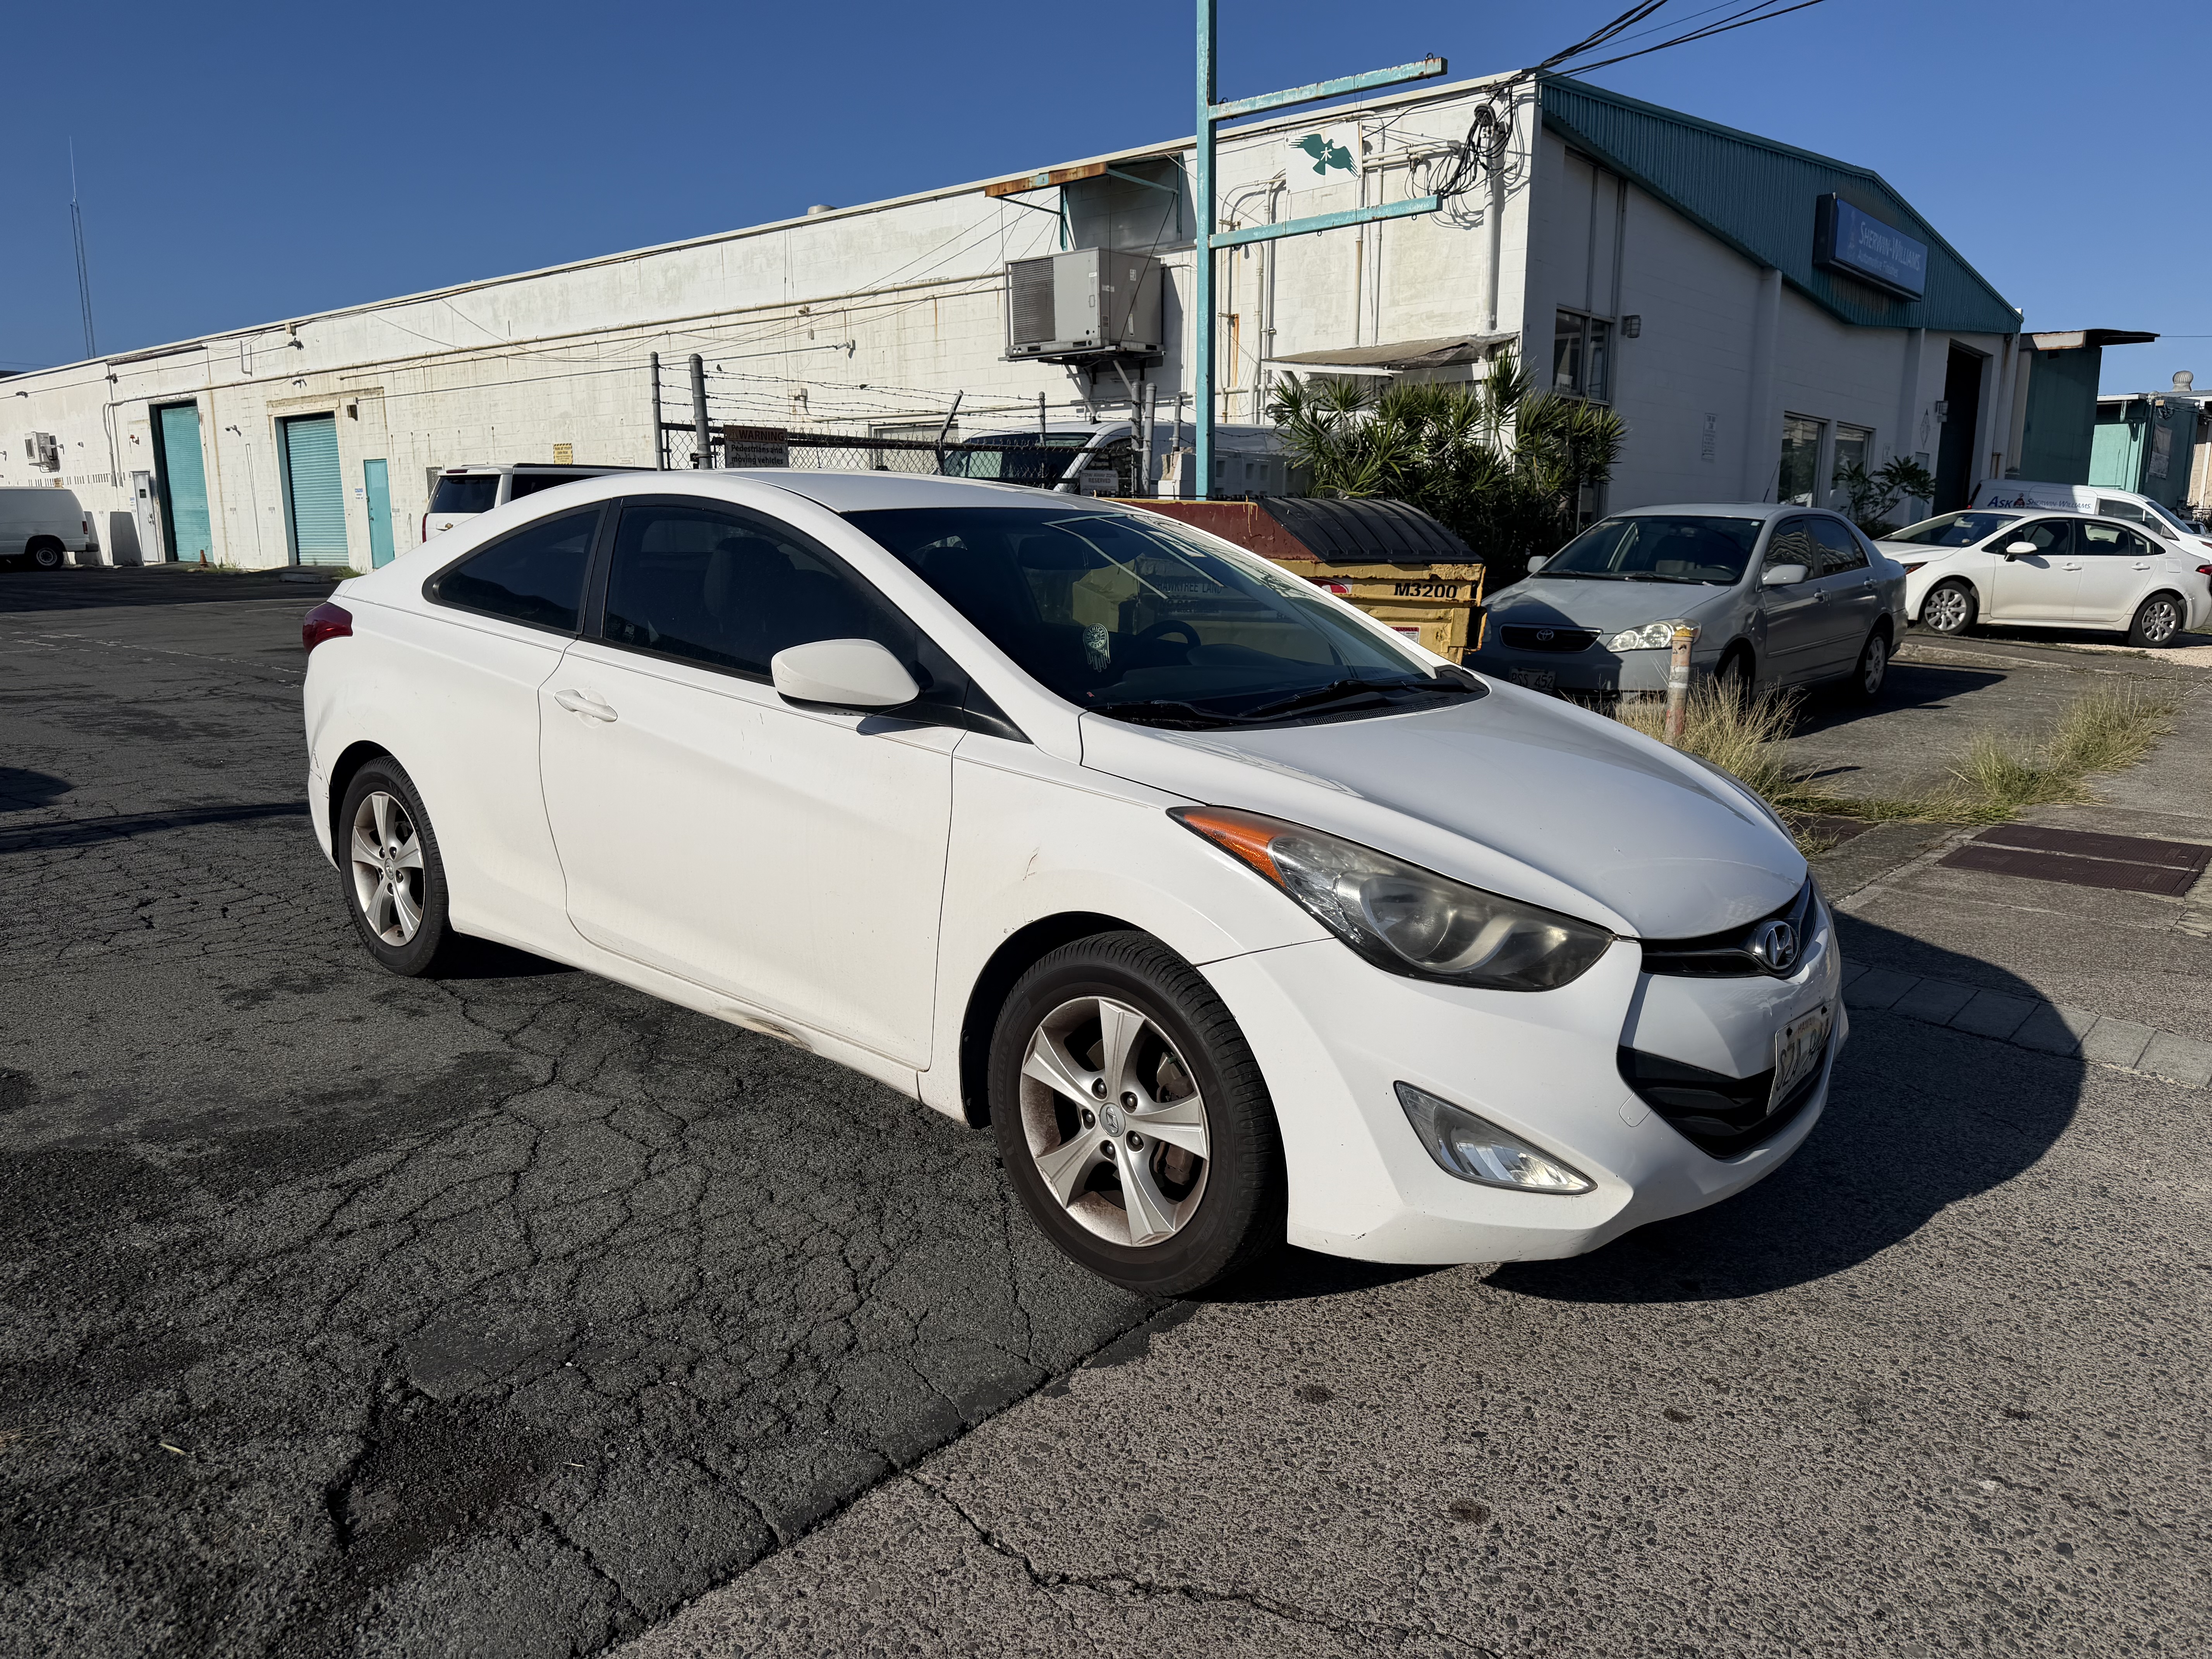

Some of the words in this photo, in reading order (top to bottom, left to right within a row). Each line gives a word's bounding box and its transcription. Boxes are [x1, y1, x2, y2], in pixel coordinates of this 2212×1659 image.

[1321, 147, 1332, 161] 木
[739, 430, 784, 441] WARNING
[731, 443, 769, 453] Pedestrians
[1202, 583, 1222, 594] LAND
[1394, 582, 1457, 598] M3200
[1534, 675, 1553, 689] 452
